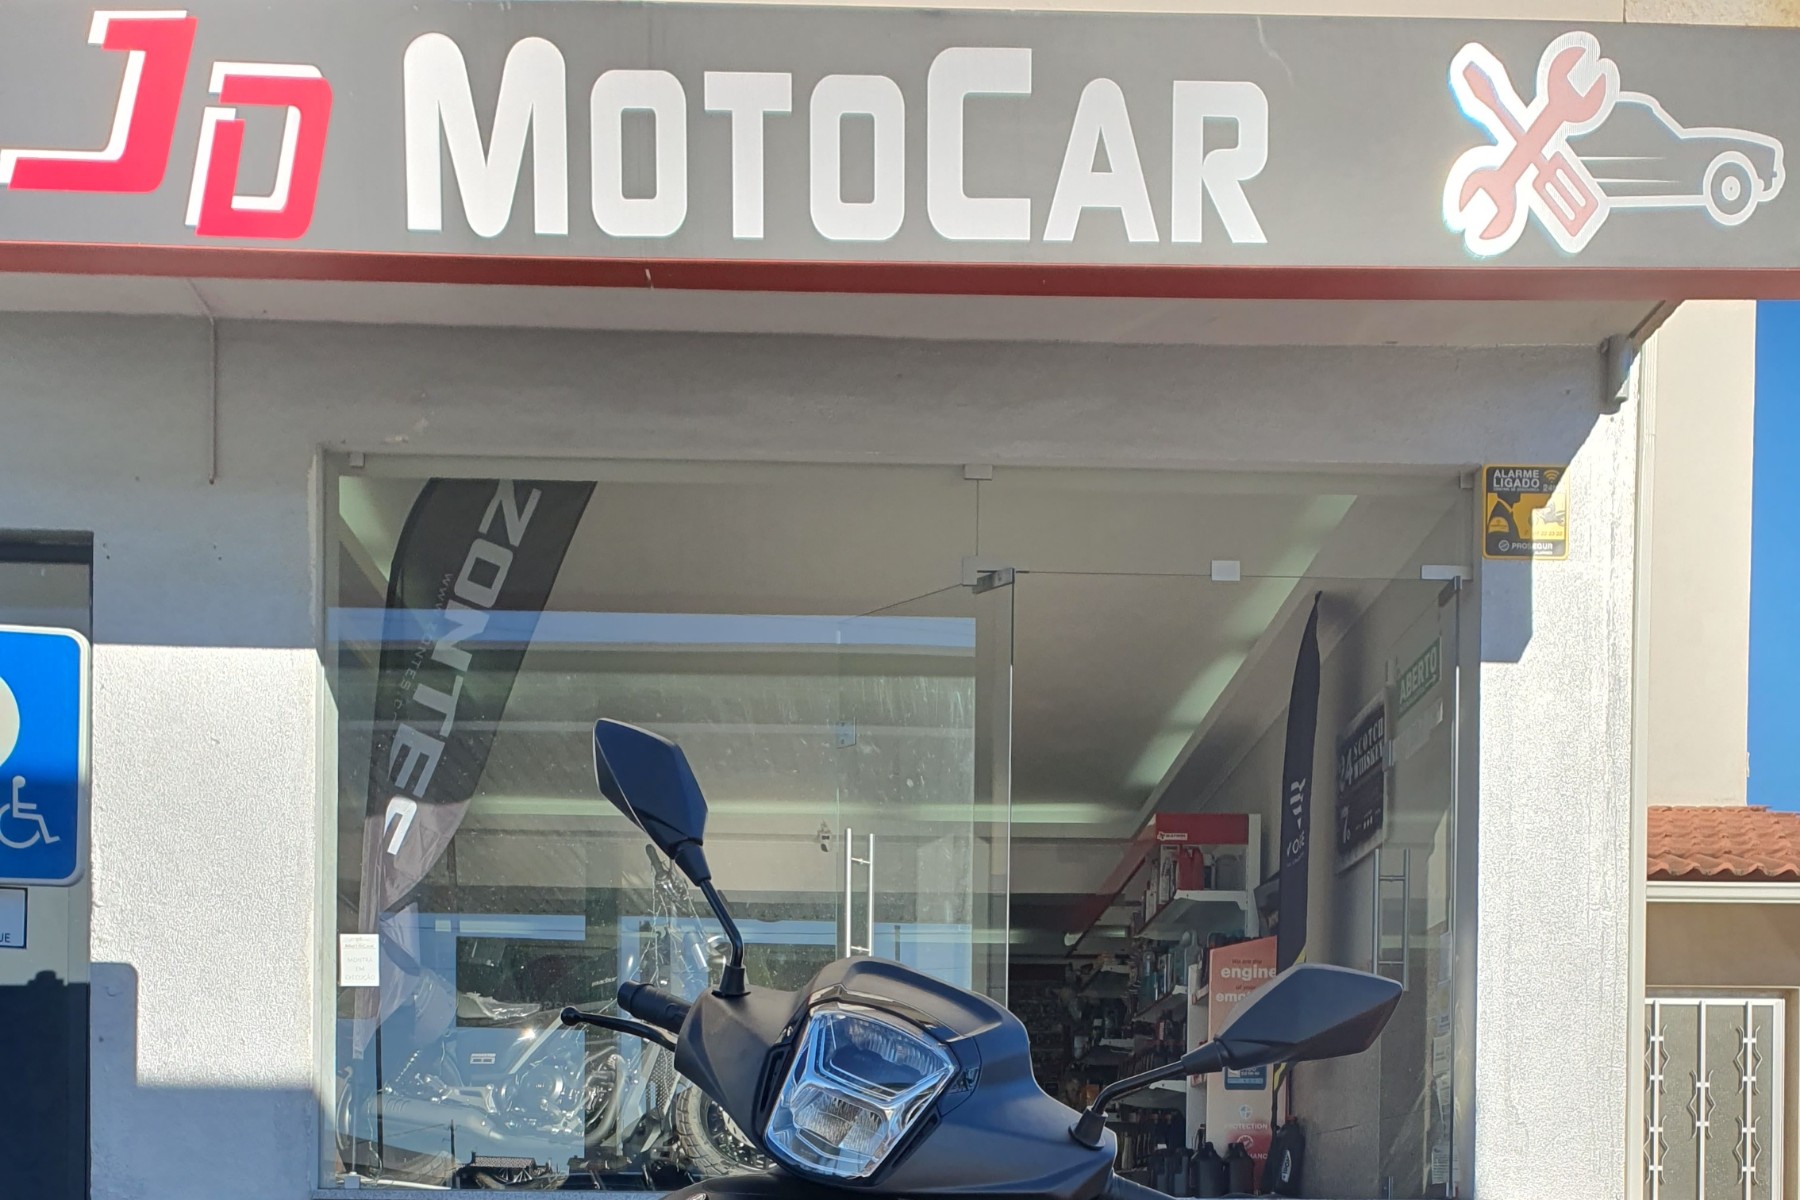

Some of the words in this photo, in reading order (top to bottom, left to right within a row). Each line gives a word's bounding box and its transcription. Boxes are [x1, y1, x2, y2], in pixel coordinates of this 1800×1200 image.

[1493, 469, 1540, 479] ALARME
[1493, 479, 1540, 488] LIGADO
[1400, 646, 1437, 704] ABERTO
[1354, 716, 1384, 758] SCOTCH
[1221, 964, 1276, 981] engine
